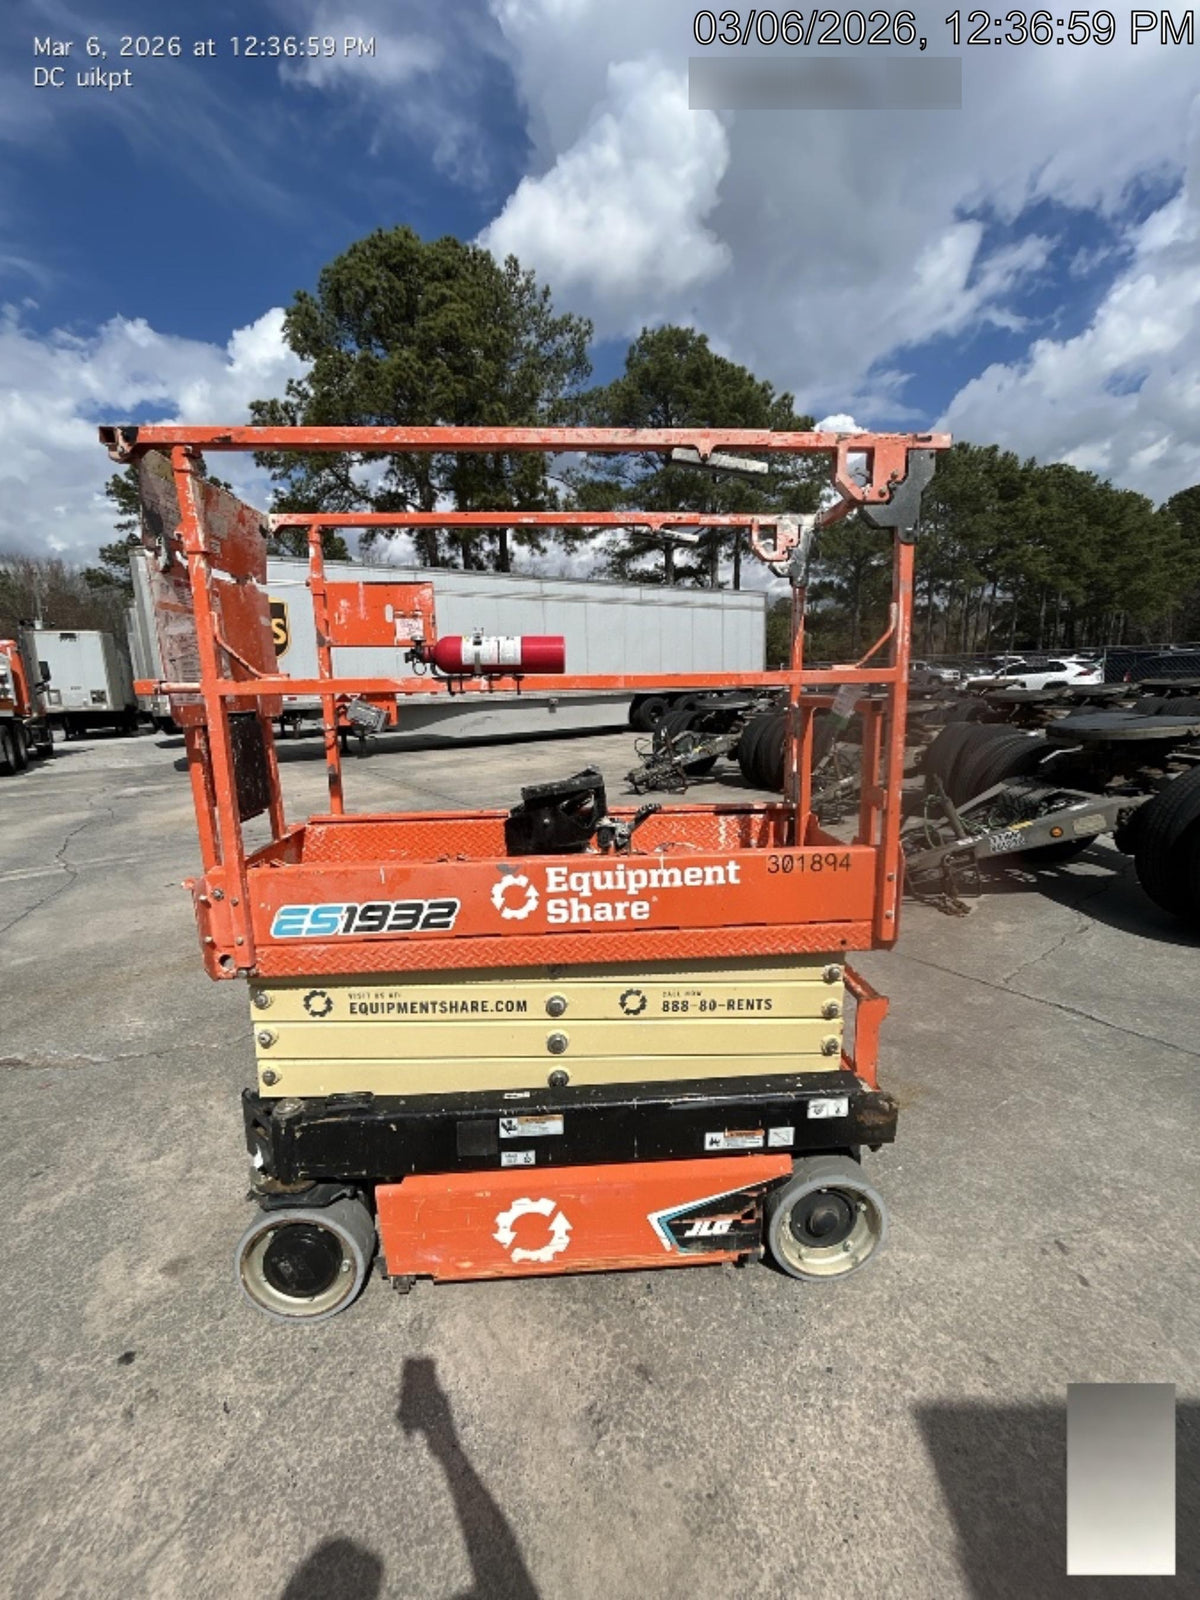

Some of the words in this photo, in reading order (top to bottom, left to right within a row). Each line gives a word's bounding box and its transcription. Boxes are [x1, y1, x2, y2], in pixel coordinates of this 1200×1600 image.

[767, 852, 852, 875] 301894
[545, 860, 741, 897] Equipment
[271, 899, 459, 937] ES1932
[546, 897, 650, 924] Share
[349, 1000, 528, 1015] EQUIPMENTSHARE.COM
[662, 998, 773, 1012] 888-80-RENTS
[684, 1219, 733, 1237] JLG
